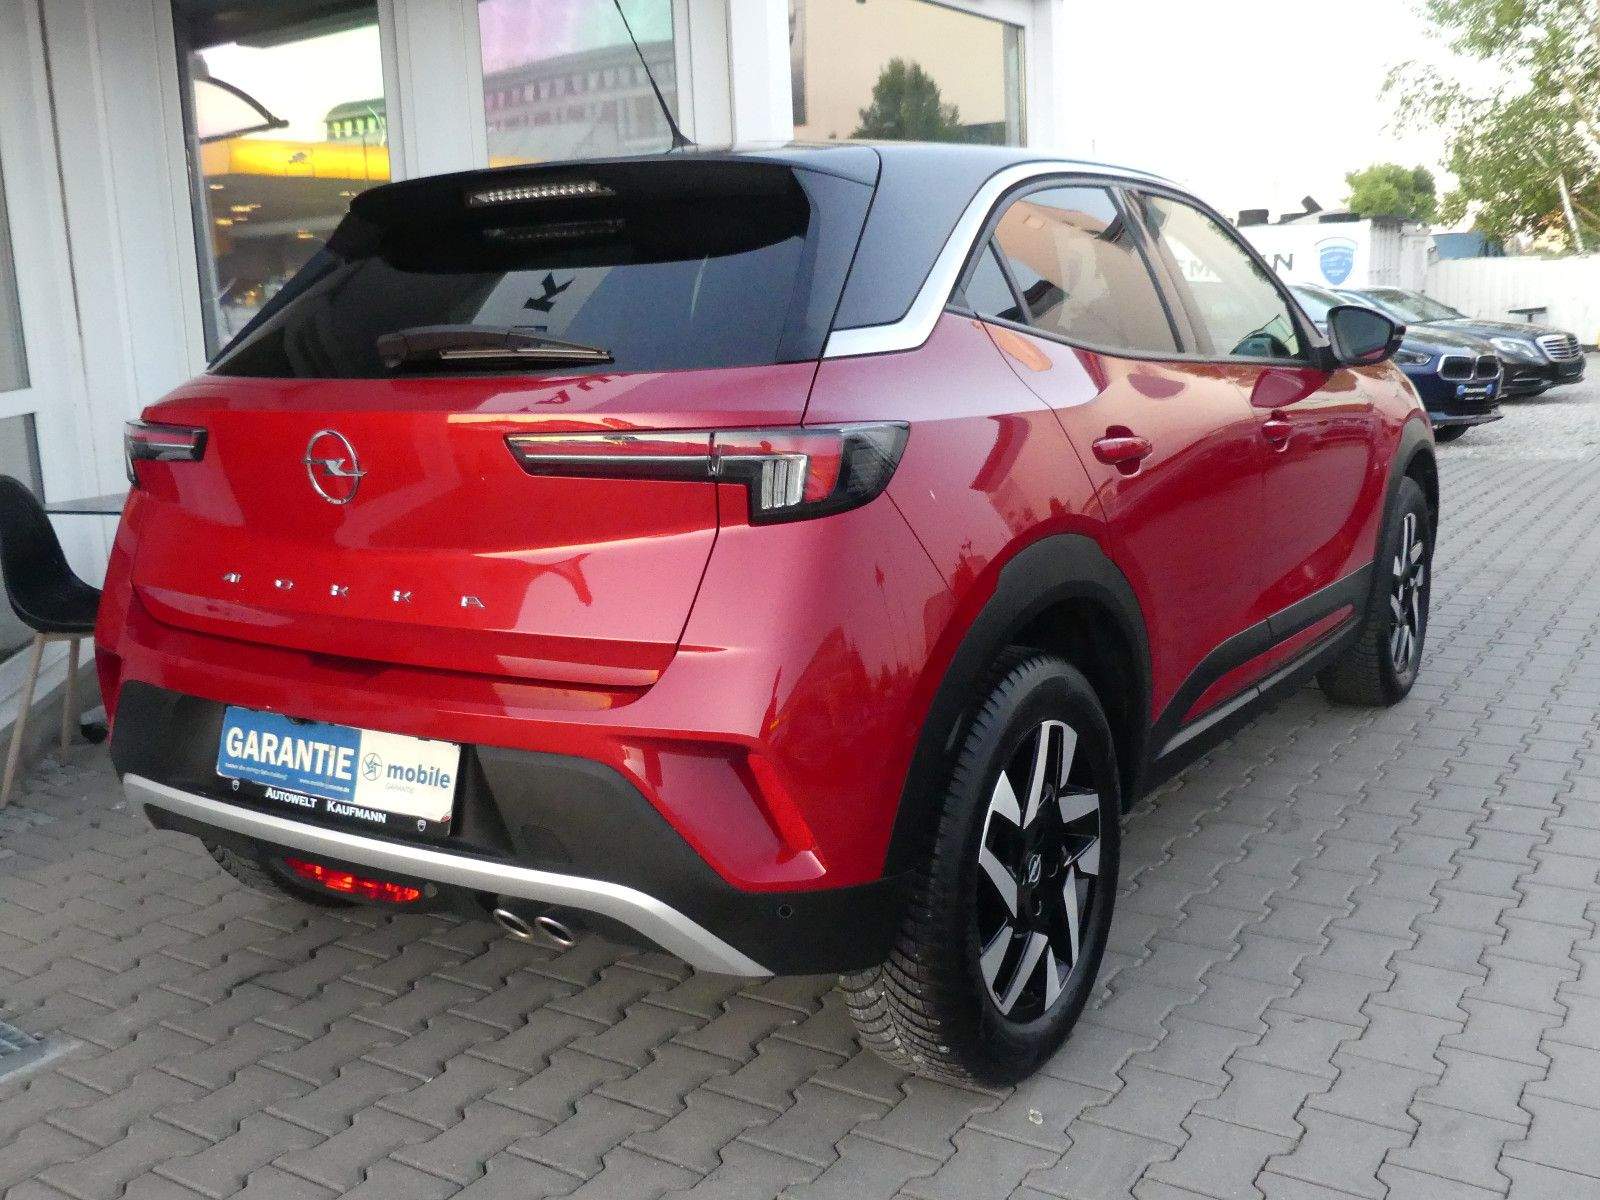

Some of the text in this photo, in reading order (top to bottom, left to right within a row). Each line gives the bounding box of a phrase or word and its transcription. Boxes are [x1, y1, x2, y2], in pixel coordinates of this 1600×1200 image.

[226, 726, 355, 780] GARANTIE
[387, 763, 451, 789] mobile
[265, 787, 386, 823] AUTOWELT KAUFMANN
